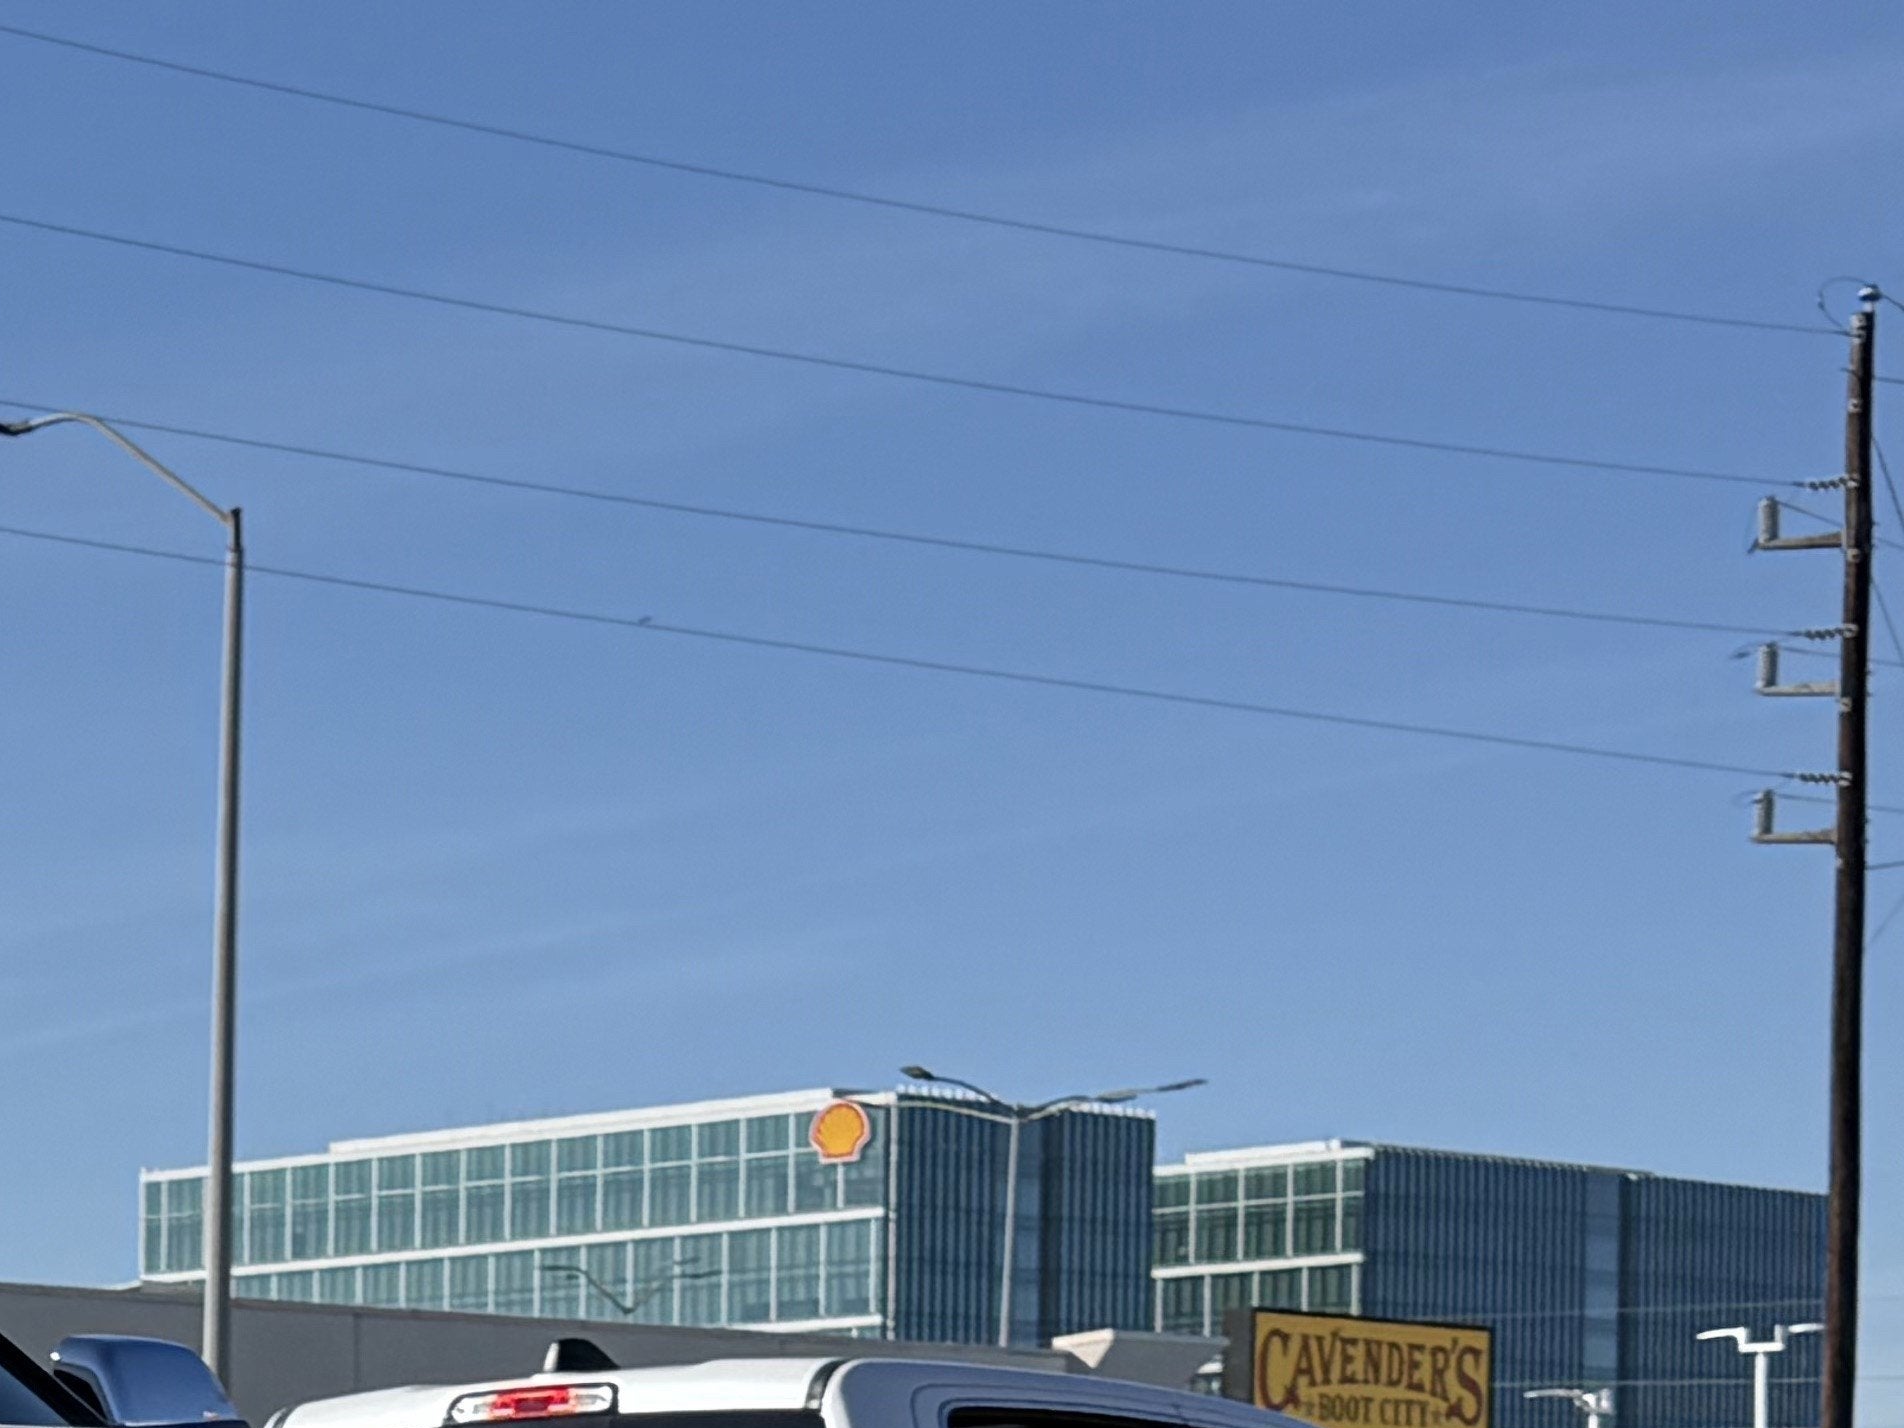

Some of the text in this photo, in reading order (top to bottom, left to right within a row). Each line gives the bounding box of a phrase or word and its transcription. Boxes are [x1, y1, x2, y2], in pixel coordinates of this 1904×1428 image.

[1259, 1328, 1483, 1427] CAVENDER'S
[1318, 1393, 1430, 1427] BOOT CITY
